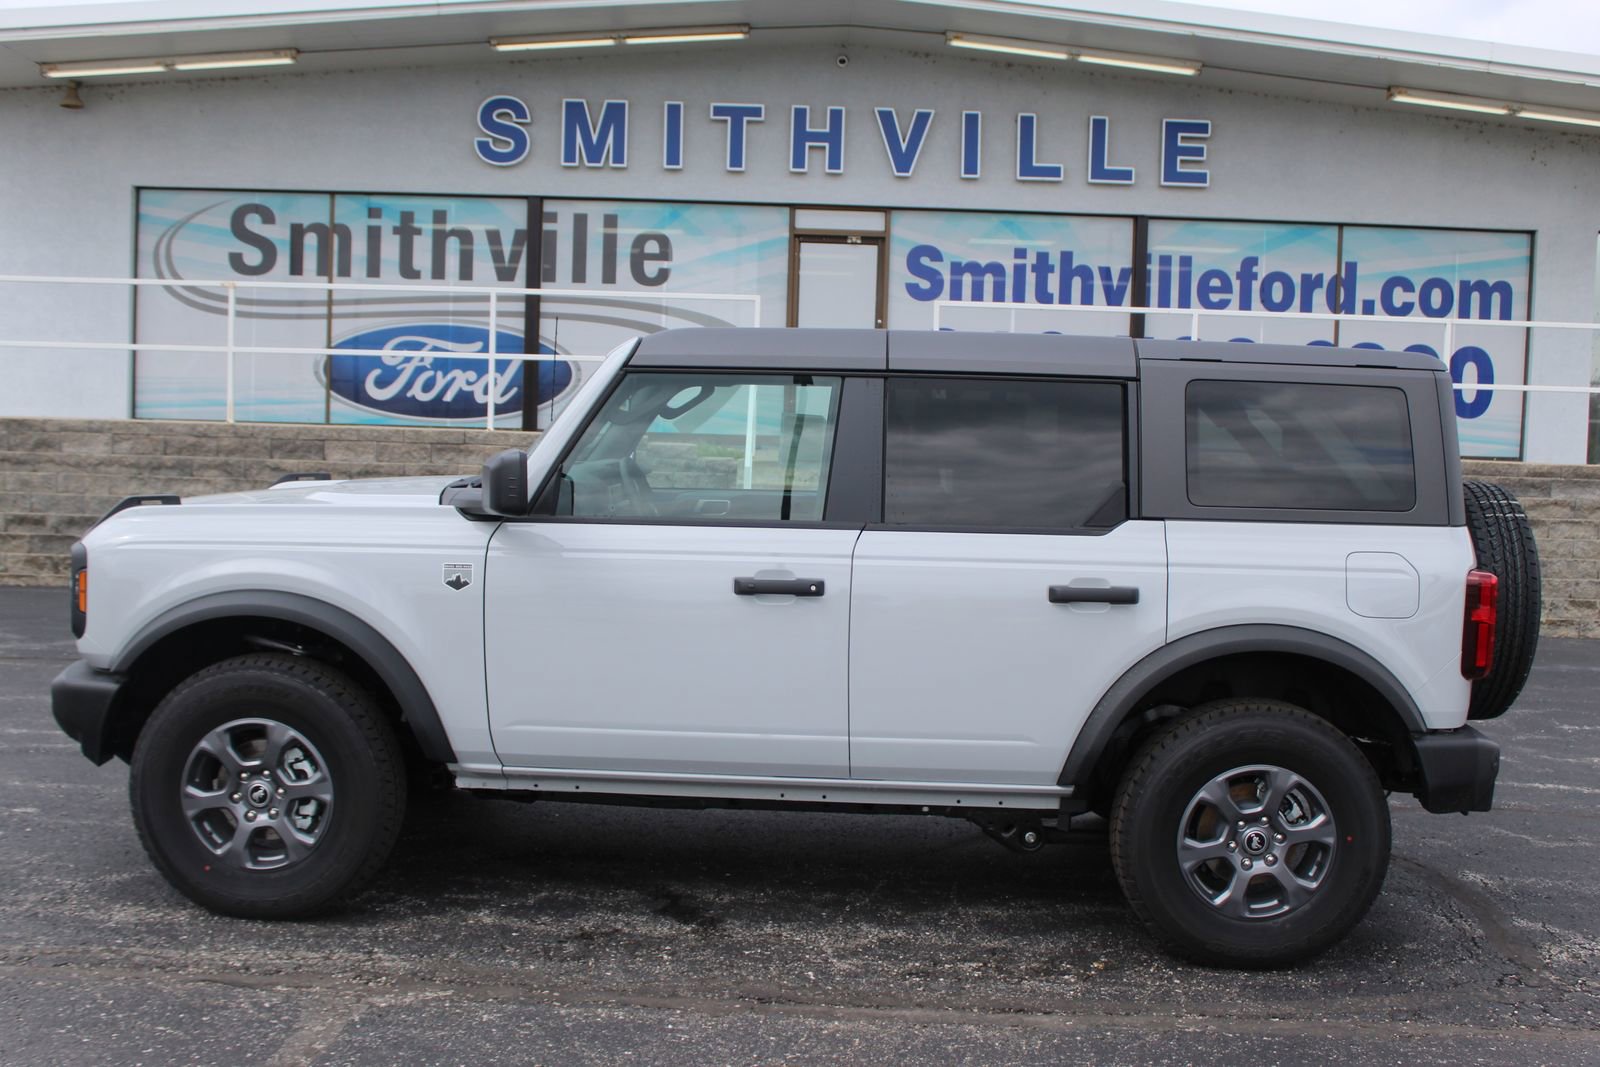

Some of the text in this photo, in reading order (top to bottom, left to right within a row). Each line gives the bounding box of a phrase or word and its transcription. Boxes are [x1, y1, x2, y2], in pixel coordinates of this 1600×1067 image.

[474, 95, 1213, 188] SMITHVILLE
[227, 202, 674, 286] Smithville
[364, 335, 525, 405] Ford
